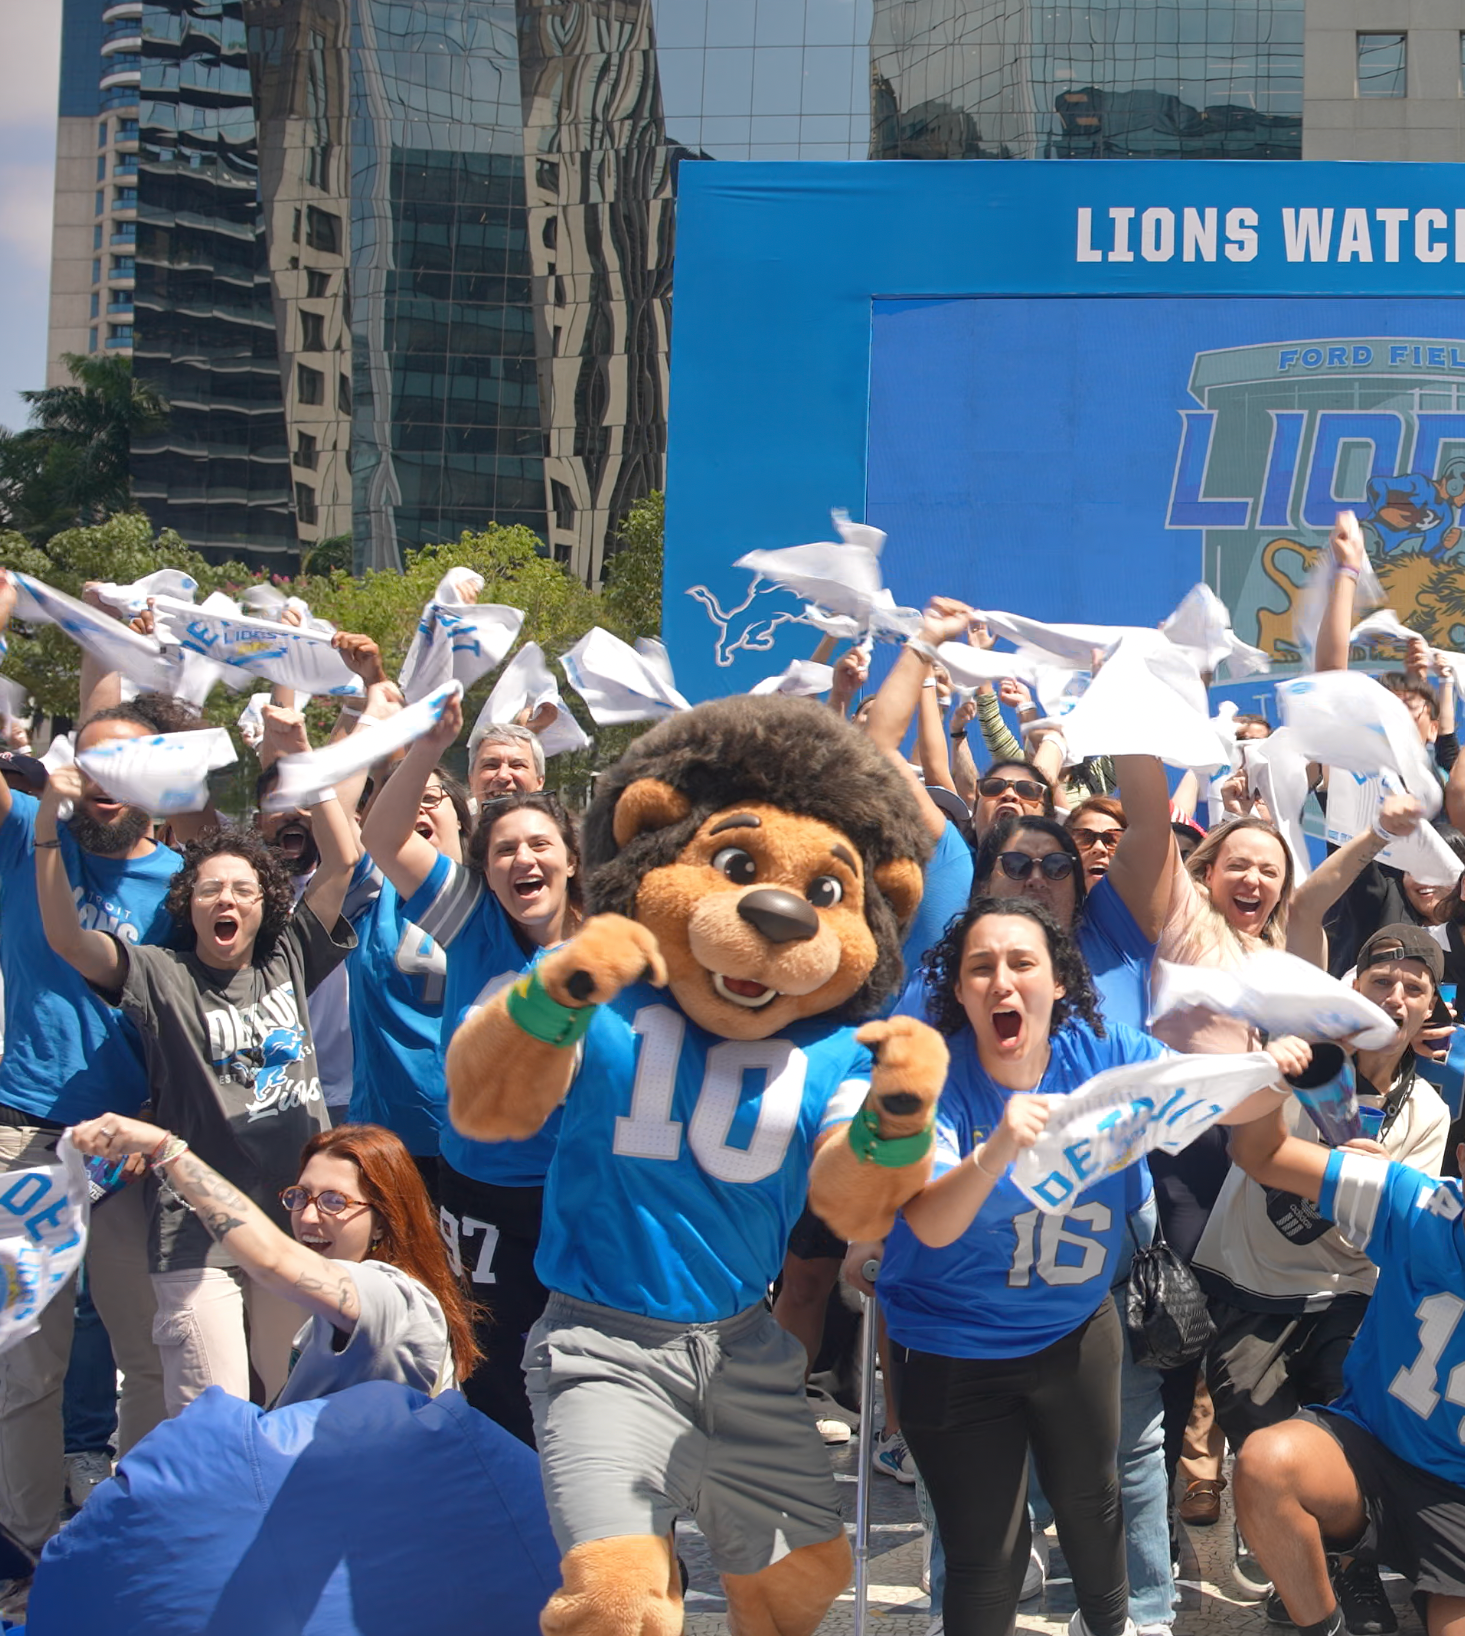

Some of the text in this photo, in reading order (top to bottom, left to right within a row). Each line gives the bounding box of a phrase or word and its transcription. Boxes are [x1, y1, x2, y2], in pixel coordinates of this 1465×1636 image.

[1077, 206, 1258, 262] LIONS
[1277, 344, 1373, 371] FORD
[613, 1003, 808, 1184] 10
[440, 1204, 500, 1284] 97
[1006, 1201, 1112, 1288] 16
